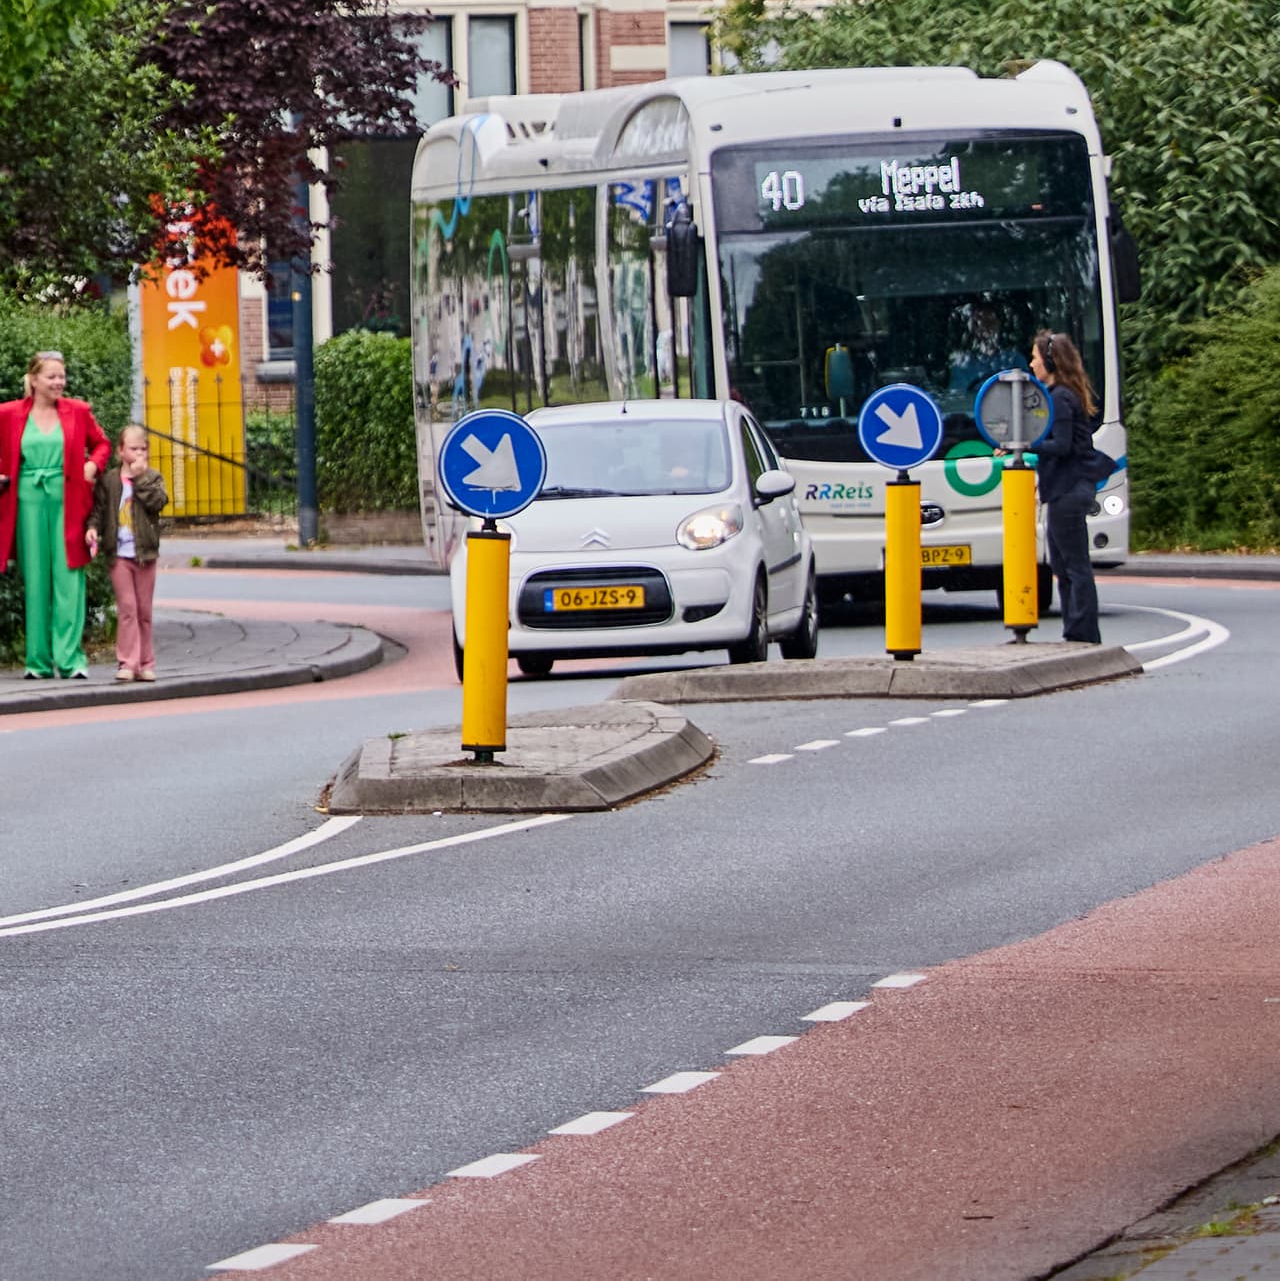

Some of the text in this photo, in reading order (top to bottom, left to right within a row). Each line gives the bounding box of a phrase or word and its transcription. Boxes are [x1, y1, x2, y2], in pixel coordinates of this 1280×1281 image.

[761, 156, 961, 212] 40 Meppel
[858, 195, 890, 214] via
[804, 481, 874, 502] RRReis
[560, 589, 637, 607] 06-JZS-9
